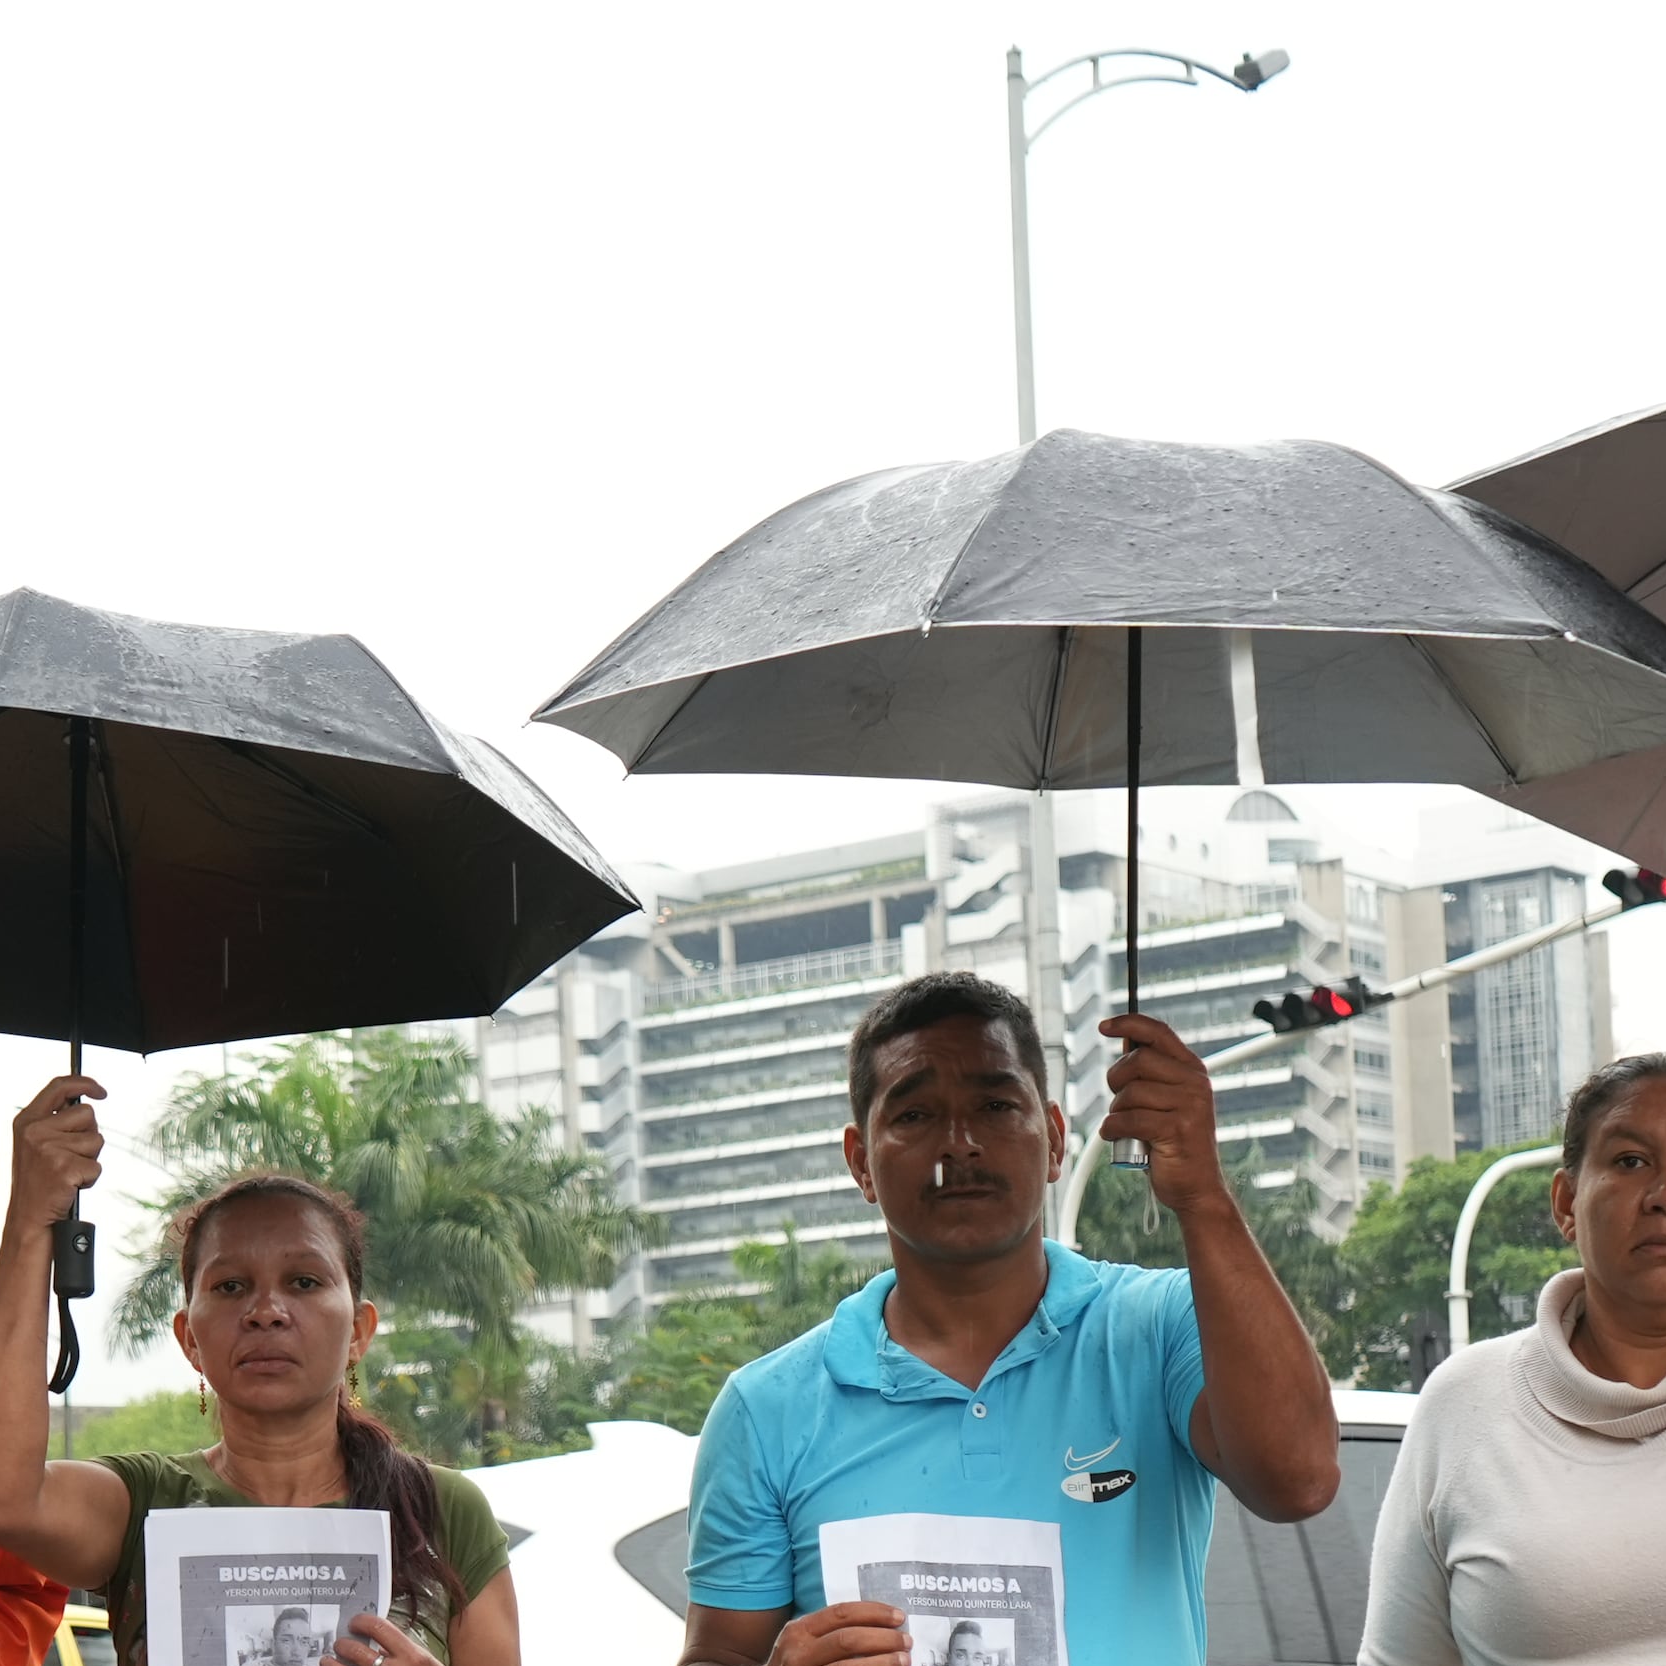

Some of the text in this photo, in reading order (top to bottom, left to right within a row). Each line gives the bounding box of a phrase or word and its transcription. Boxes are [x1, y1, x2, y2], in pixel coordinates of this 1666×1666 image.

[1067, 1473, 1132, 1493] air max
[219, 1566, 347, 1582] BUSCAMOS A
[225, 1588, 260, 1597] YERSON
[262, 1587, 290, 1596] DAVID
[291, 1586, 334, 1596] QUINTERO
[900, 1574, 1022, 1593] BUSCAMOS A
[907, 1596, 1032, 1609] YERSON DAVID QUINTERO LARA
